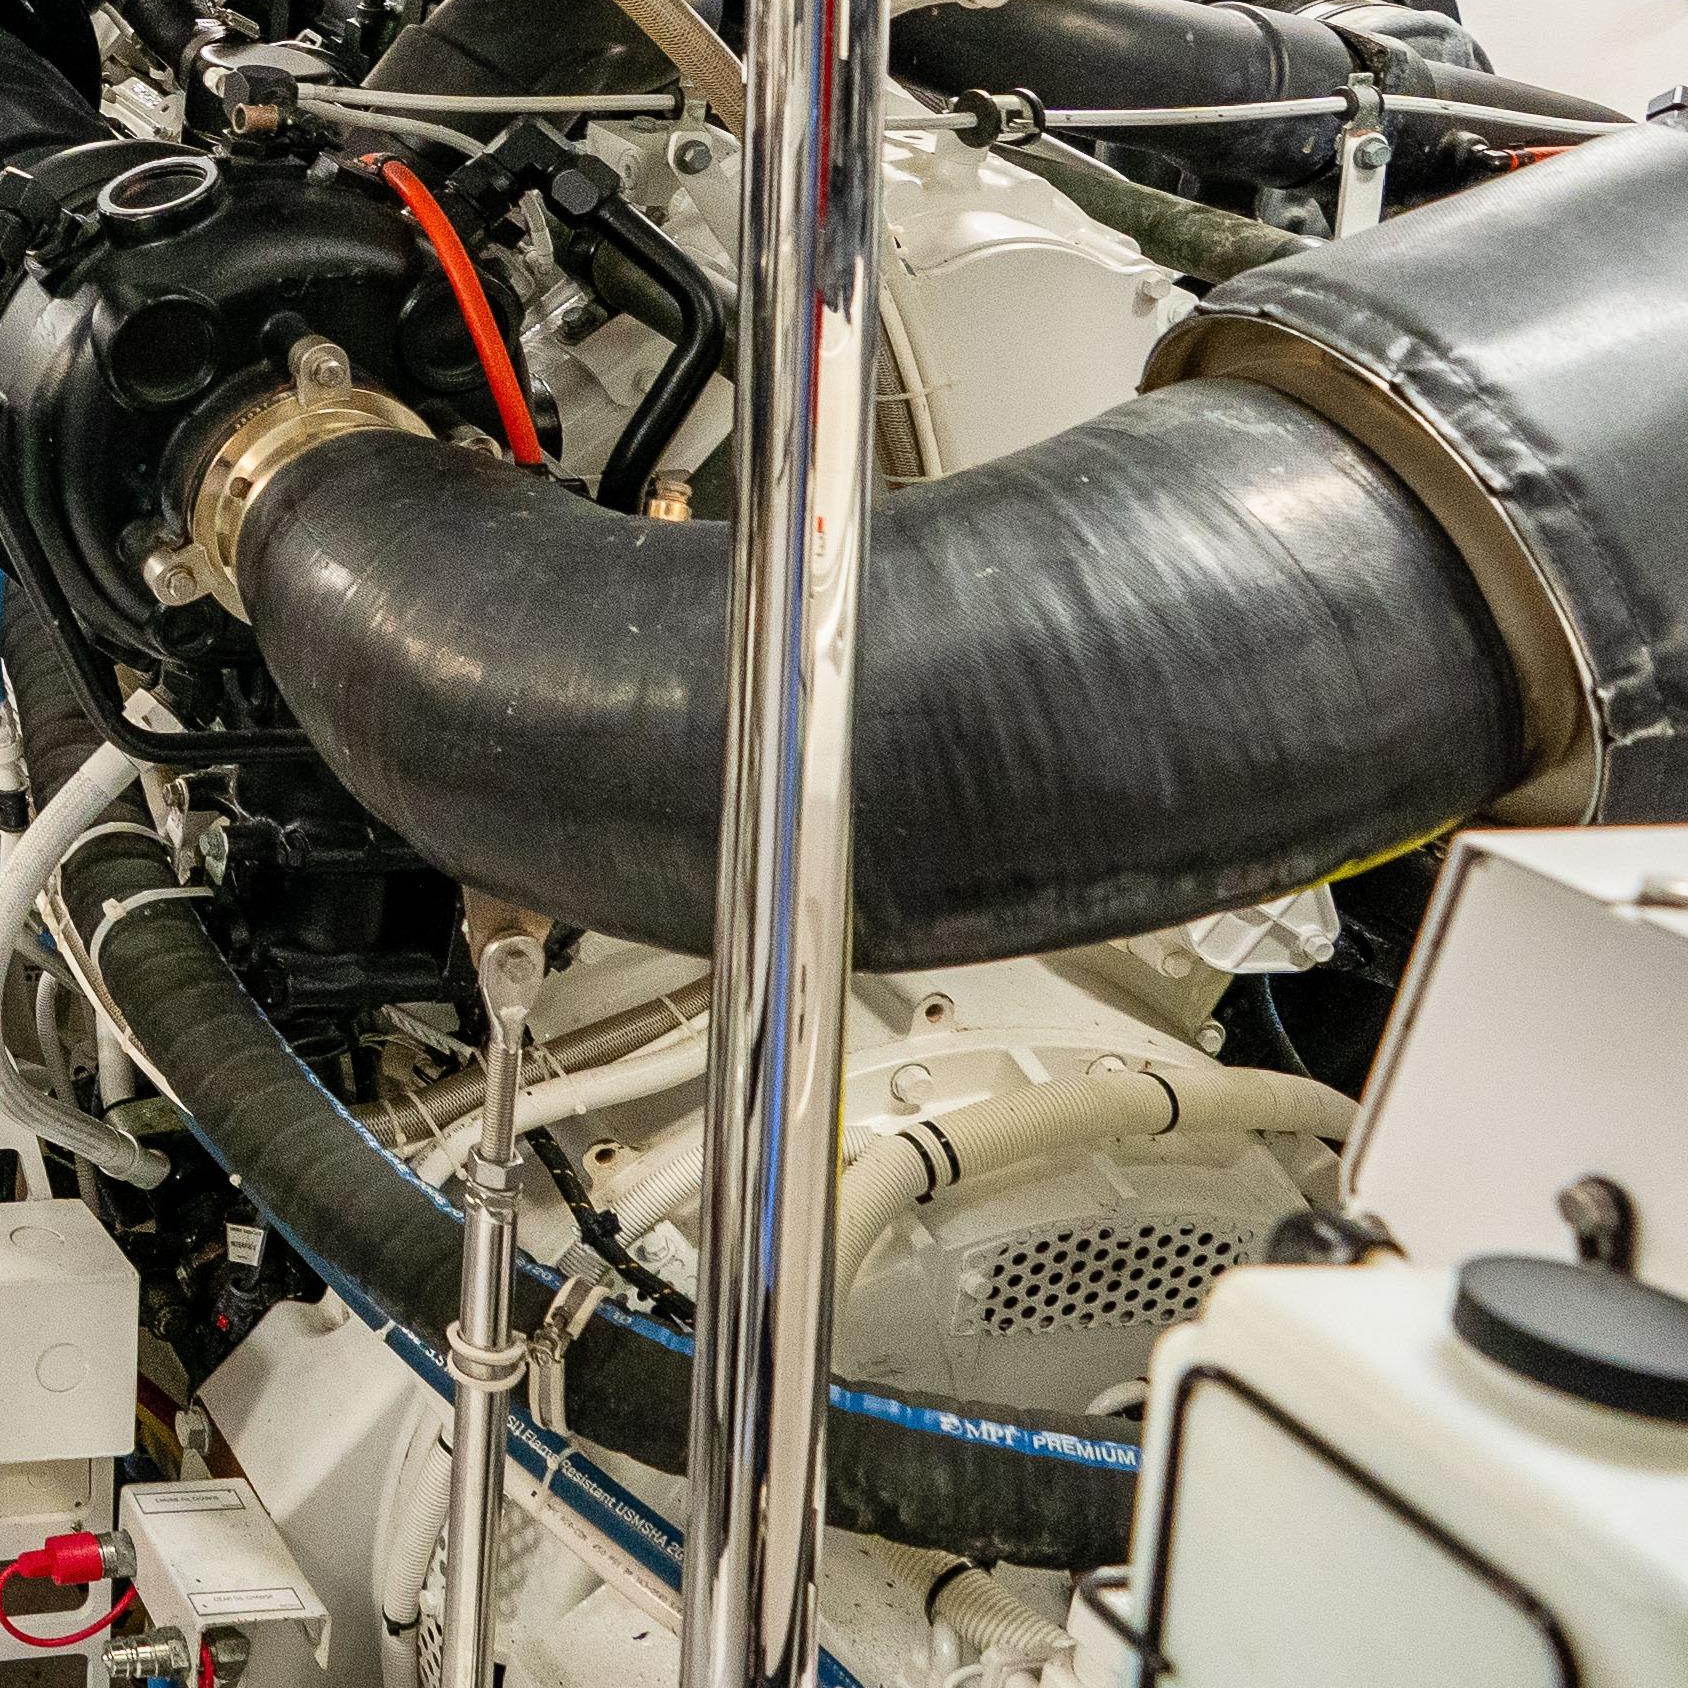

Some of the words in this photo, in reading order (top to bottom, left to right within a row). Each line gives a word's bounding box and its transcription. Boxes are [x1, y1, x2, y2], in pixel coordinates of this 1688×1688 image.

[1033, 1431, 1137, 1467] PREMIUM
[558, 1459, 617, 1510] Resistant
[616, 1504, 669, 1553] USMSHA
